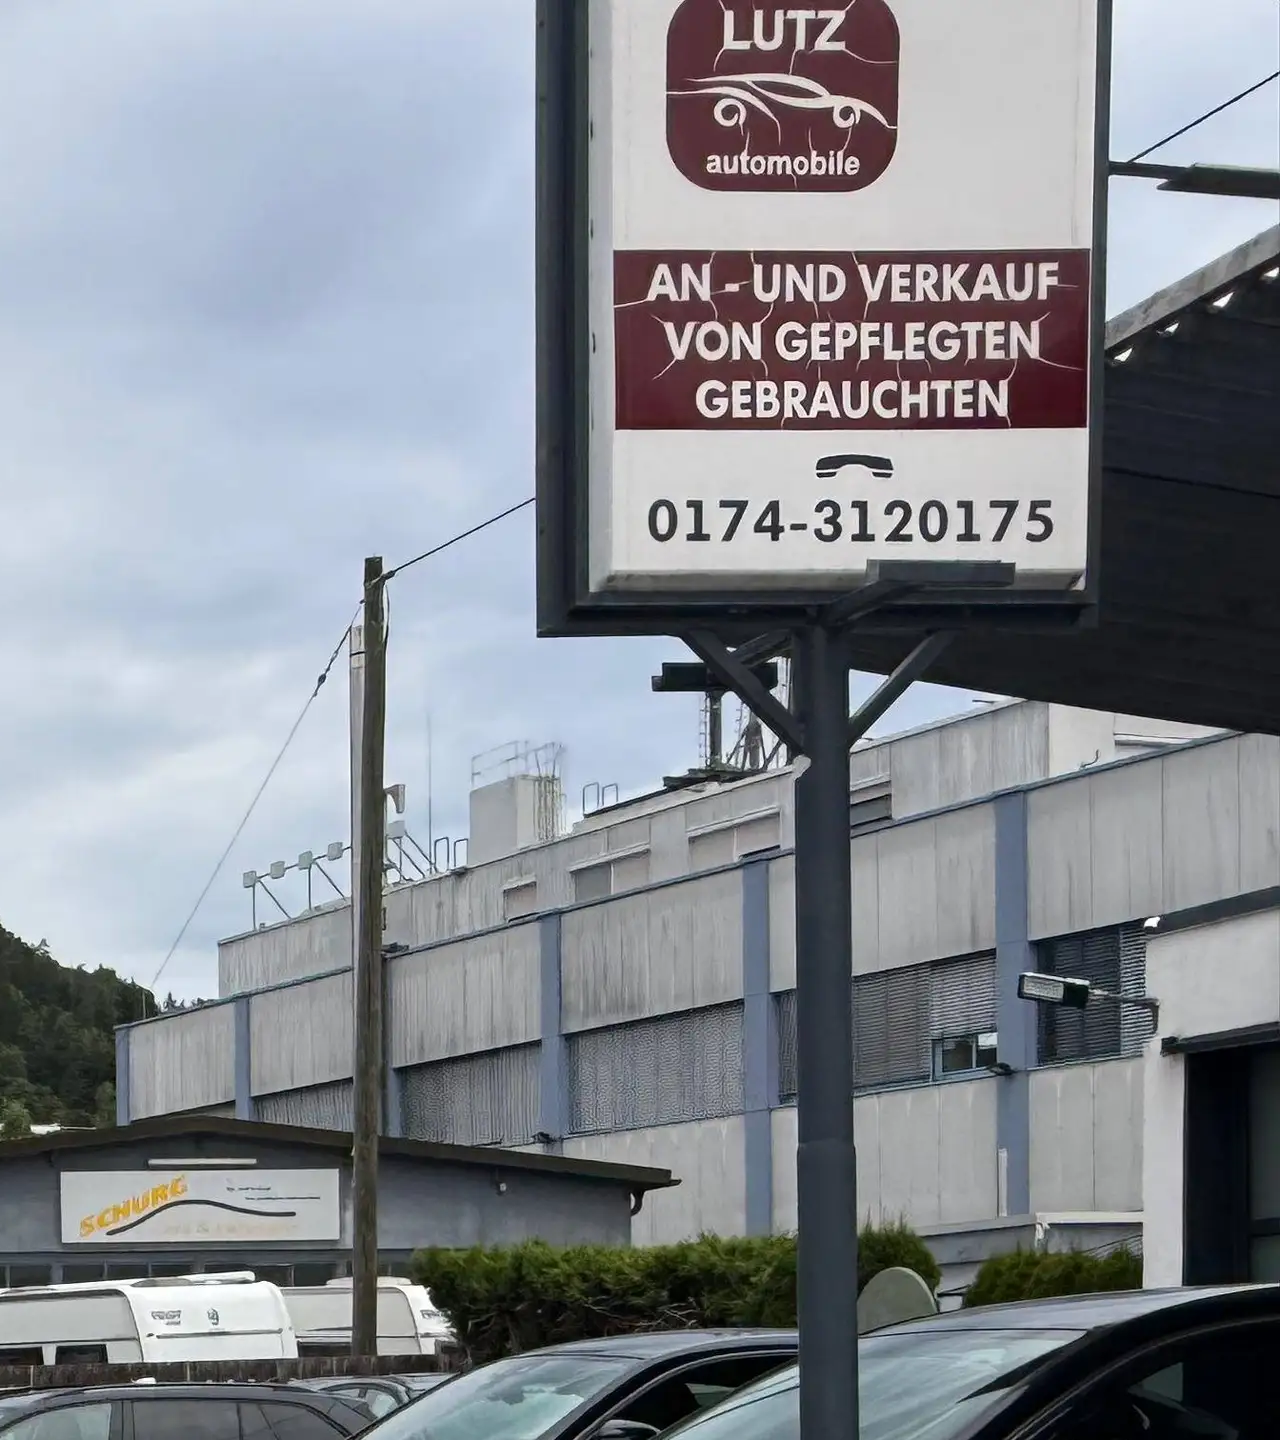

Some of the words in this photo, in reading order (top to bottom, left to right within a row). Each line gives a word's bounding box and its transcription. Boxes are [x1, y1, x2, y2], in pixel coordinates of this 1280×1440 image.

[724, 10, 846, 50] LUTZ
[706, 151, 860, 175] automobile
[753, 263, 846, 302] UND
[857, 261, 1060, 302] VERKAUF
[663, 322, 762, 361] VON
[775, 321, 1040, 361] GEPFLEGTEN
[695, 380, 1008, 419] GEBRAUCHTEN
[647, 499, 1054, 542] 0174-3120175
